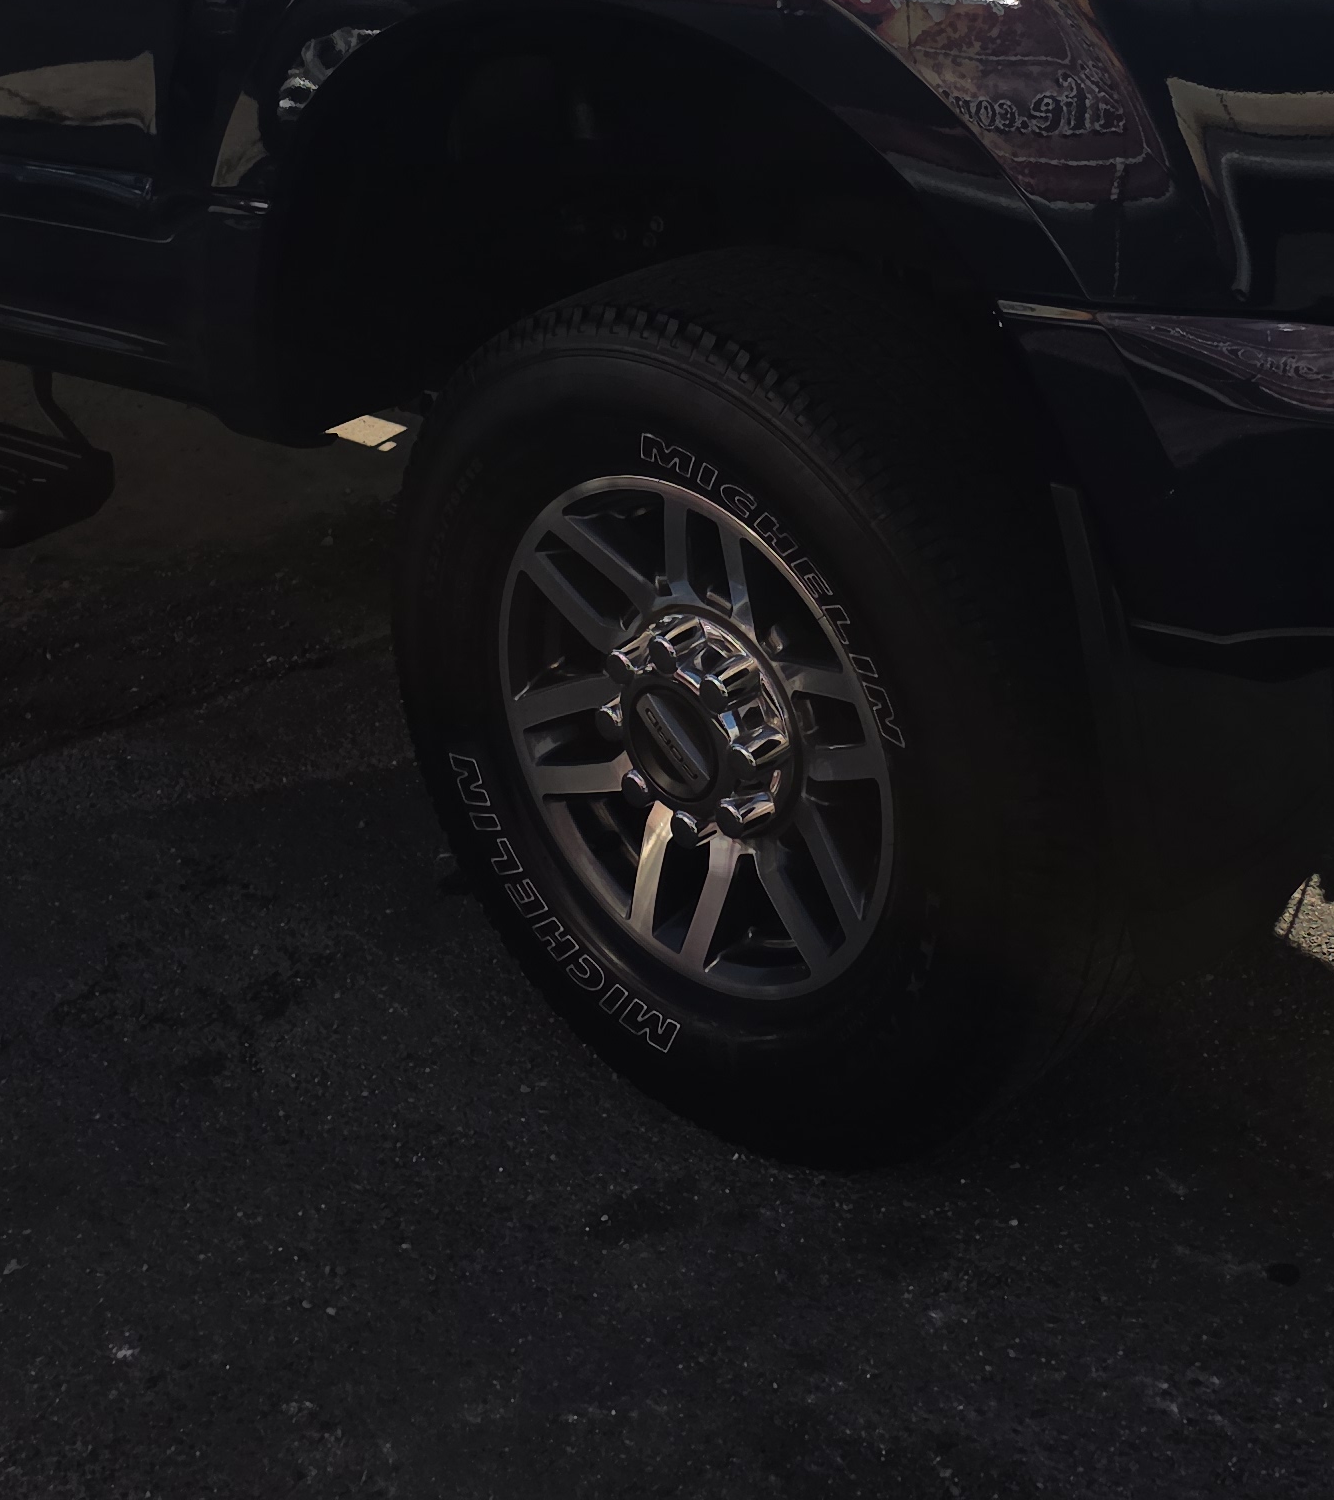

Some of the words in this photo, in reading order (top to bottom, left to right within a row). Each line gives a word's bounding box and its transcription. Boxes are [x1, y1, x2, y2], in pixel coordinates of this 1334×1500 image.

[639, 431, 906, 749] MICHELIN
[643, 705, 701, 783] FORD
[448, 752, 682, 1054] MICHELIN
